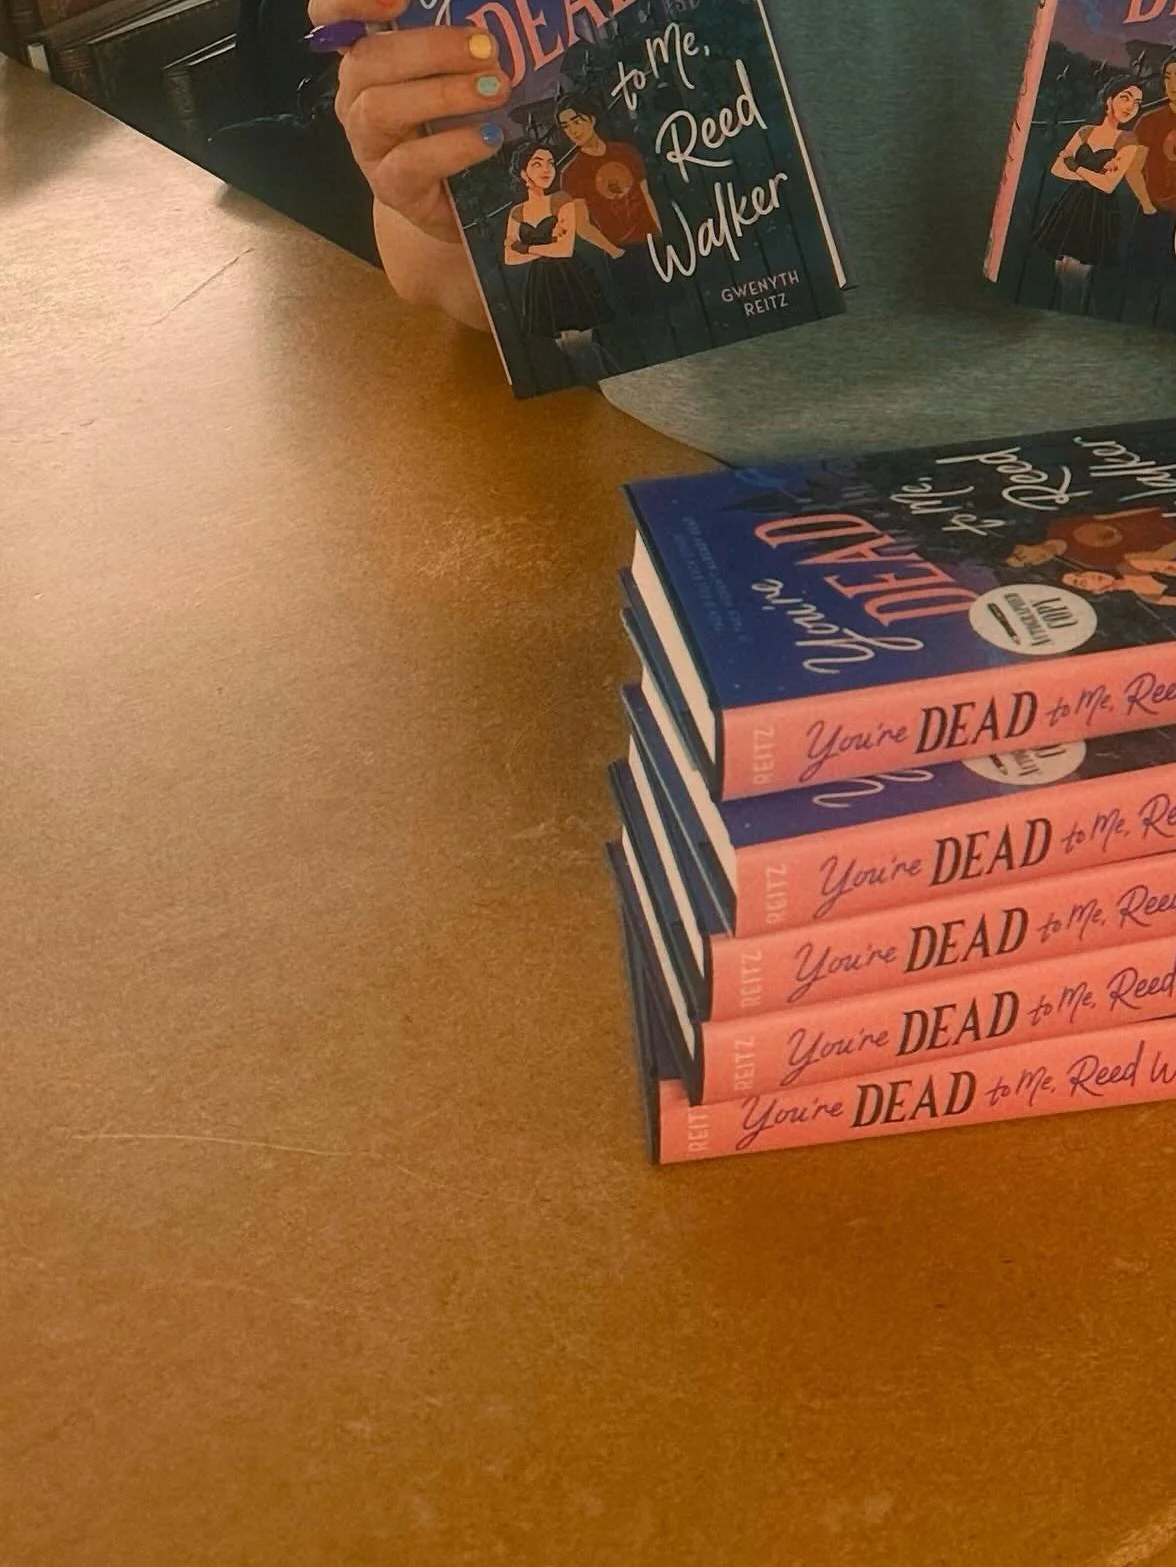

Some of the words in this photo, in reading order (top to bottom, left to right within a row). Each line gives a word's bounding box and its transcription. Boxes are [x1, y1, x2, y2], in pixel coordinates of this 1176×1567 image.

[611, 61, 646, 111] to
[646, 22, 710, 89] Me,
[655, 59, 767, 183] Reed
[647, 172, 788, 283] Walker
[721, 270, 800, 303] GWENYTH
[744, 293, 788, 316] REITZ
[889, 476, 975, 515] Me,
[936, 446, 1093, 510] Reed
[941, 513, 1005, 536] to
[754, 513, 979, 626] DEAD
[751, 578, 925, 674] You're
[1031, 597, 1078, 629] COPY
[752, 725, 775, 785] REITZ
[799, 720, 907, 782] You're
[914, 691, 1037, 755] DEAD
[1046, 697, 1070, 726] to
[766, 864, 788, 926] REITZ
[812, 856, 922, 919] You're
[929, 817, 1052, 886] DEAD
[1060, 823, 1085, 855] to
[740, 950, 762, 1008] REITZ
[787, 942, 898, 1004] You're
[904, 907, 1029, 974] DEAD
[1037, 912, 1060, 943] to
[735, 1037, 755, 1090] REITZ
[780, 1028, 889, 1087] You're
[896, 991, 1020, 1057] DEAD
[1027, 995, 1051, 1026] to
[736, 1095, 844, 1150] You're
[850, 1070, 976, 1128] DEAD
[985, 1079, 1010, 1106] to
[1067, 1040, 1145, 1097] Reed
[687, 1105, 709, 1152] REIT
